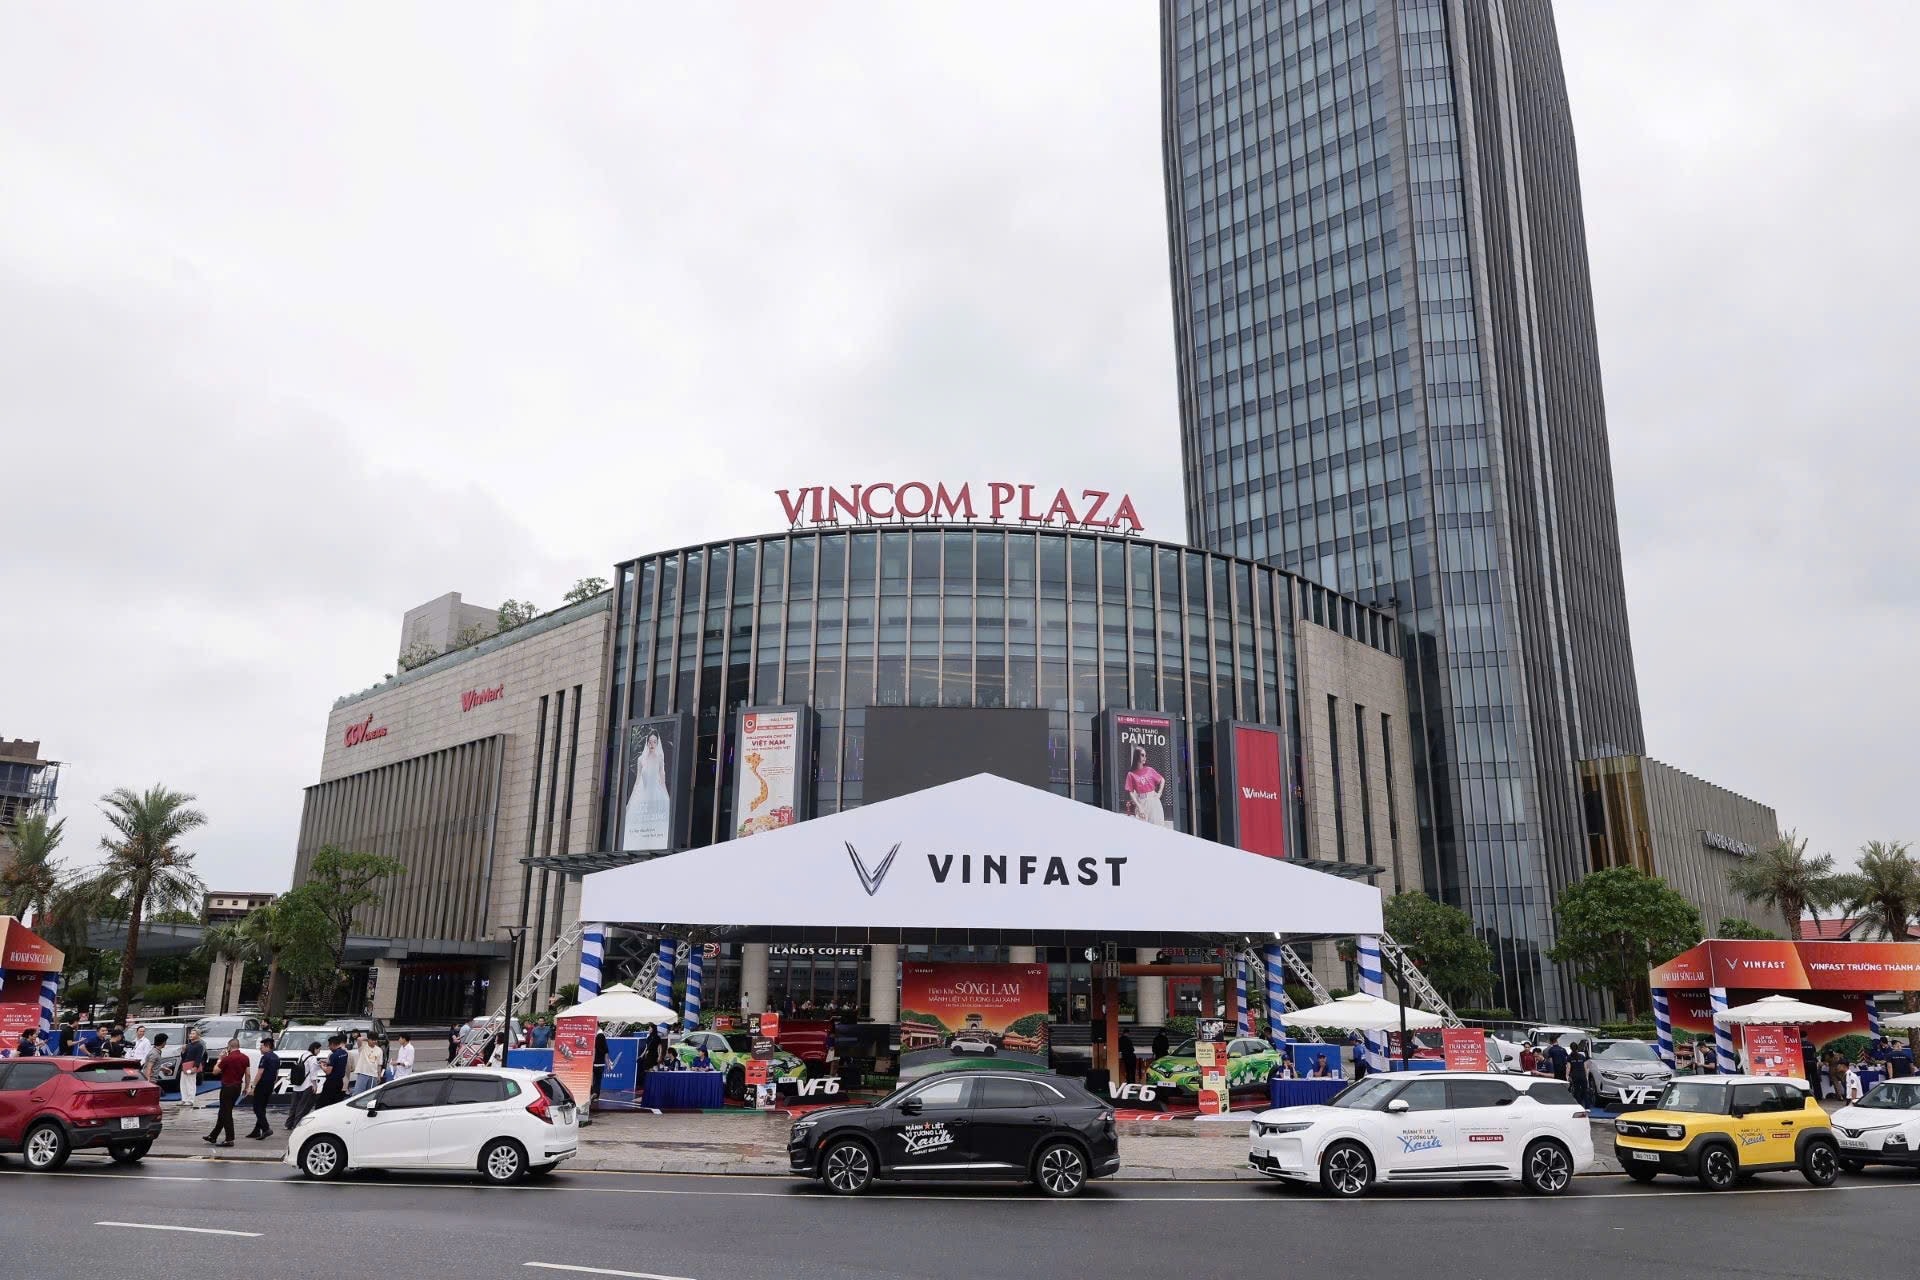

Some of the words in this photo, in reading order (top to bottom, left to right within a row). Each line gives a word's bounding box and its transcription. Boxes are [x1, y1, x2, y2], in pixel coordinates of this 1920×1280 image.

[775, 481, 978, 525] VINCOM
[987, 482, 1145, 531] PLAZA
[462, 684, 504, 712] WinMart
[1121, 732, 1166, 746] PANTIO
[1241, 786, 1277, 800] WinMart
[927, 853, 1128, 887] VINFAST
[818, 947, 864, 956] COFFEE
[1743, 961, 1785, 969] VINFAST
[1810, 963, 1845, 971] VINFAST
[1847, 962, 1881, 971] TRƯỜNG
[1885, 962, 1914, 971] THÀNH
[955, 980, 989, 995] SÔNG
[992, 983, 1020, 995] LAM
[797, 1077, 842, 1097] VF6
[1108, 1081, 1158, 1102] VF6
[896, 1130, 954, 1153] Xanh
